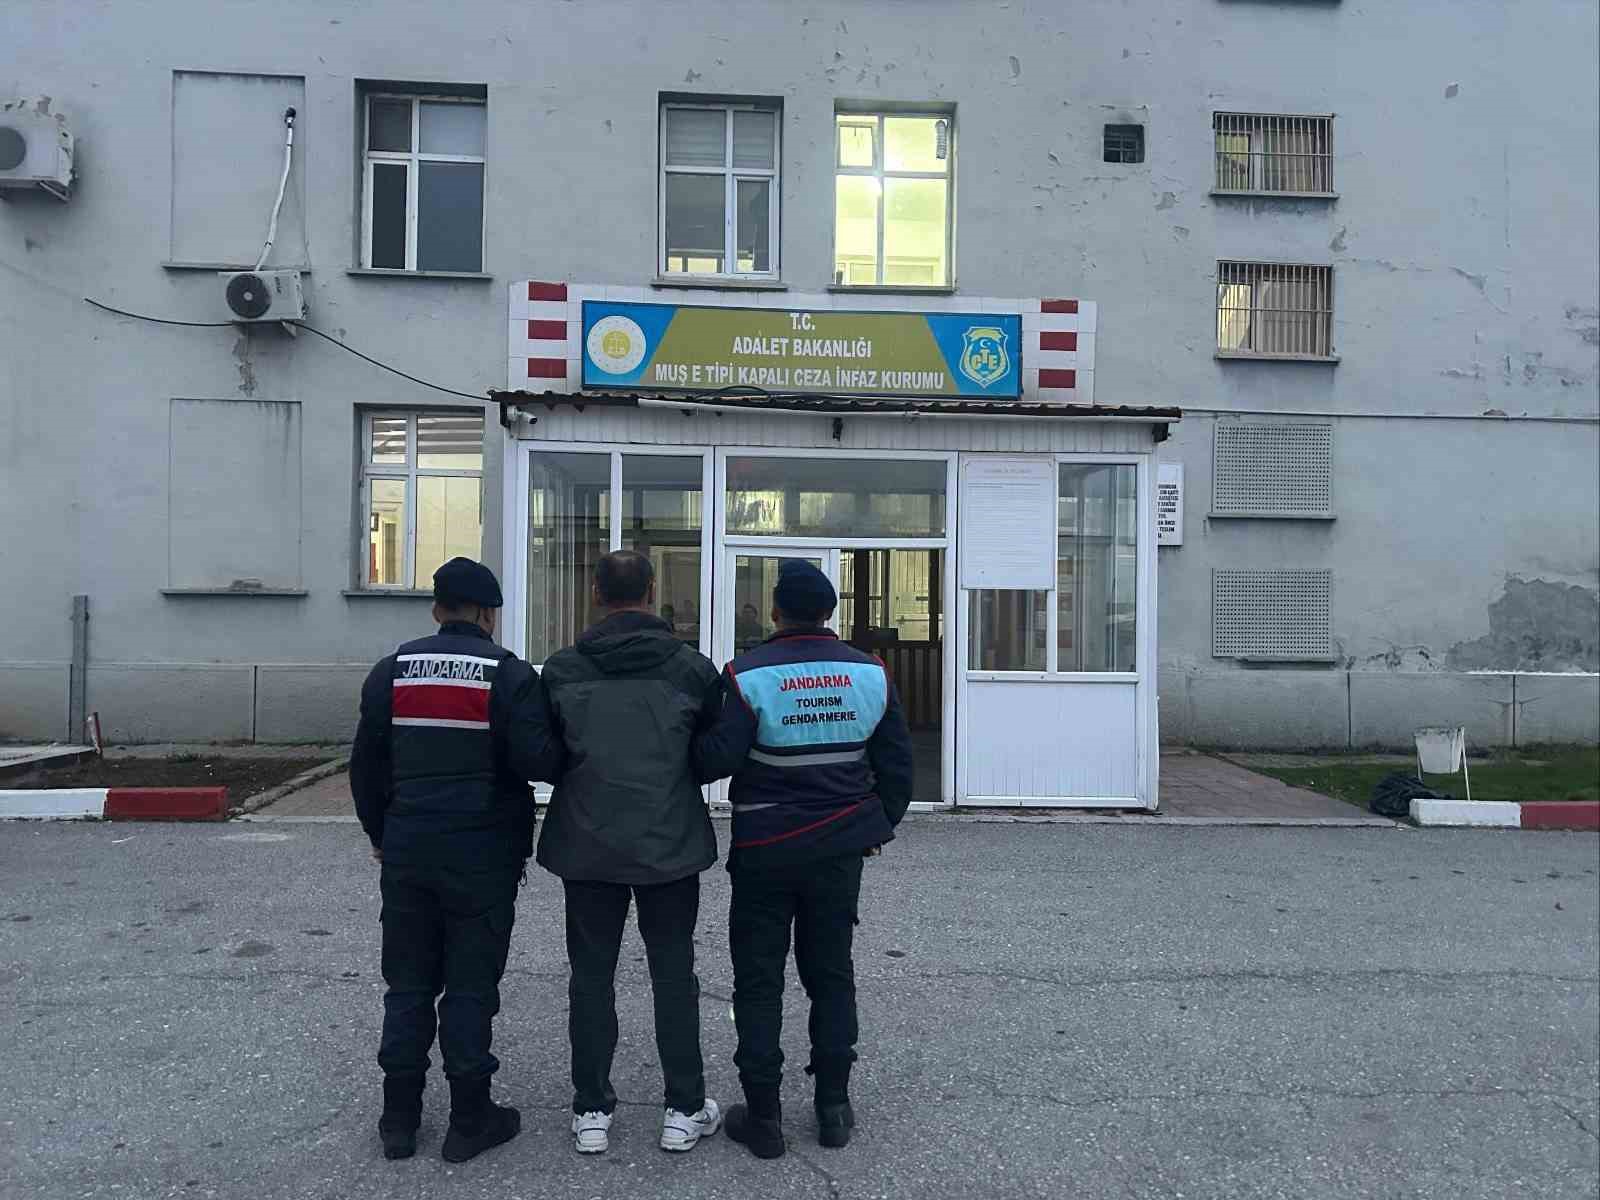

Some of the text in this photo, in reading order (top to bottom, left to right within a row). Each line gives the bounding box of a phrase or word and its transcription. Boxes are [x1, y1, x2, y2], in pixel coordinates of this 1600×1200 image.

[790, 312, 816, 331] T.C.
[732, 336, 872, 358] ADALET BAKANLIĞI
[655, 361, 945, 390] MUŞ E TİPİ KAPALI CEZA İNFAZ KURUMU
[402, 660, 484, 681] JANDARMA
[779, 674, 853, 692] JANDARMA
[781, 710, 857, 726] GENDARMERIE
